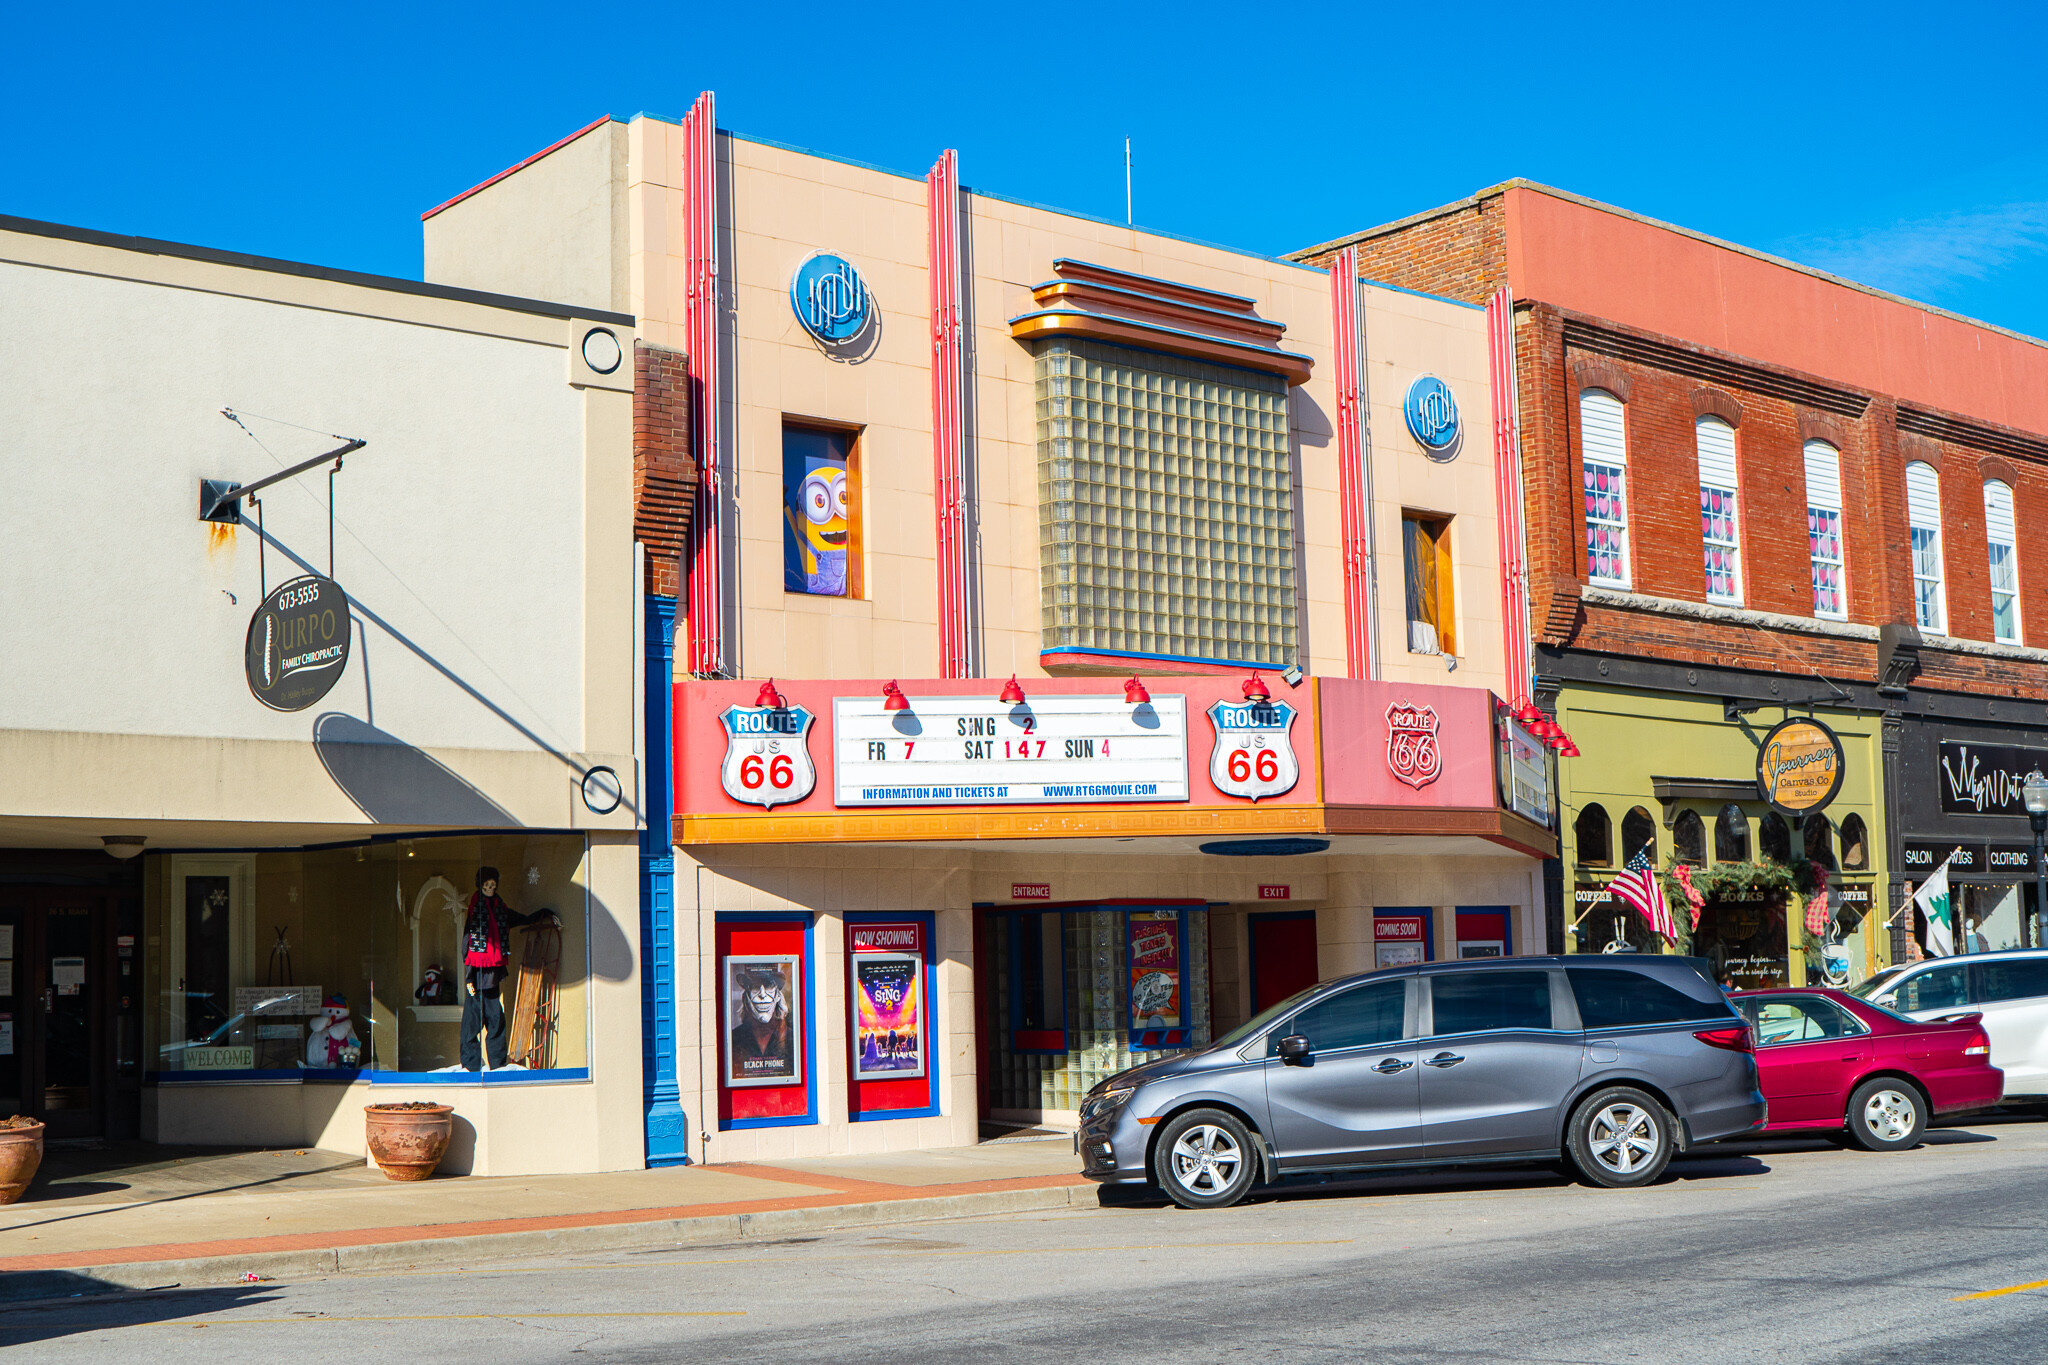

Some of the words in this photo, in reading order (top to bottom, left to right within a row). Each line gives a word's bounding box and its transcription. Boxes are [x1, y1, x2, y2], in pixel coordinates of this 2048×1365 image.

[279, 583, 319, 610] 673-5555
[281, 655, 301, 670] FAMILY
[301, 644, 342, 664] CHIROPRACTIC
[737, 713, 797, 732] ROUTE
[1023, 717, 1034, 735] 2
[1223, 709, 1281, 727] ROUTE
[1392, 712, 1431, 729] ROUTE
[868, 741, 886, 761] FR
[904, 741, 915, 760] 7
[964, 740, 994, 759] SAT
[1065, 739, 1094, 758] SUN
[1101, 739, 1110, 757] 4
[1394, 734, 1437, 772] 66
[740, 755, 794, 789] 66
[1228, 749, 1278, 782] 66
[1767, 742, 1836, 803] Journey
[1780, 779, 1815, 787] Canvas
[1816, 775, 1831, 785] Co.
[862, 787, 929, 800] INFORMATION
[932, 786, 952, 799] AND
[955, 786, 995, 798] TICKETS
[997, 786, 1008, 797] AT
[1043, 783, 1157, 797] WWW.RT66MOVIE.COM
[1795, 789, 1817, 797] Studio
[1905, 850, 1932, 864] SALON
[1950, 850, 1972, 864] WIGS
[1991, 852, 2028, 865] CLOTHING
[1013, 885, 1049, 897] ENTRANCE
[1264, 887, 1285, 897] EXIT
[1575, 890, 1612, 902] COFFEE
[1718, 891, 1765, 903] BOOKS
[1838, 890, 1867, 901] COFFEE
[854, 931, 874, 946] NOW
[875, 929, 914, 945] SHOWING
[1376, 923, 1399, 936] COMING
[1400, 922, 1417, 935] SOON
[1140, 935, 1166, 952] TICKETS
[875, 988, 901, 1003] SING
[885, 999, 893, 1011] 2
[186, 1050, 252, 1066] WELCOME
[744, 1060, 764, 1069] BLACK
[764, 1059, 784, 1068] PHONE
